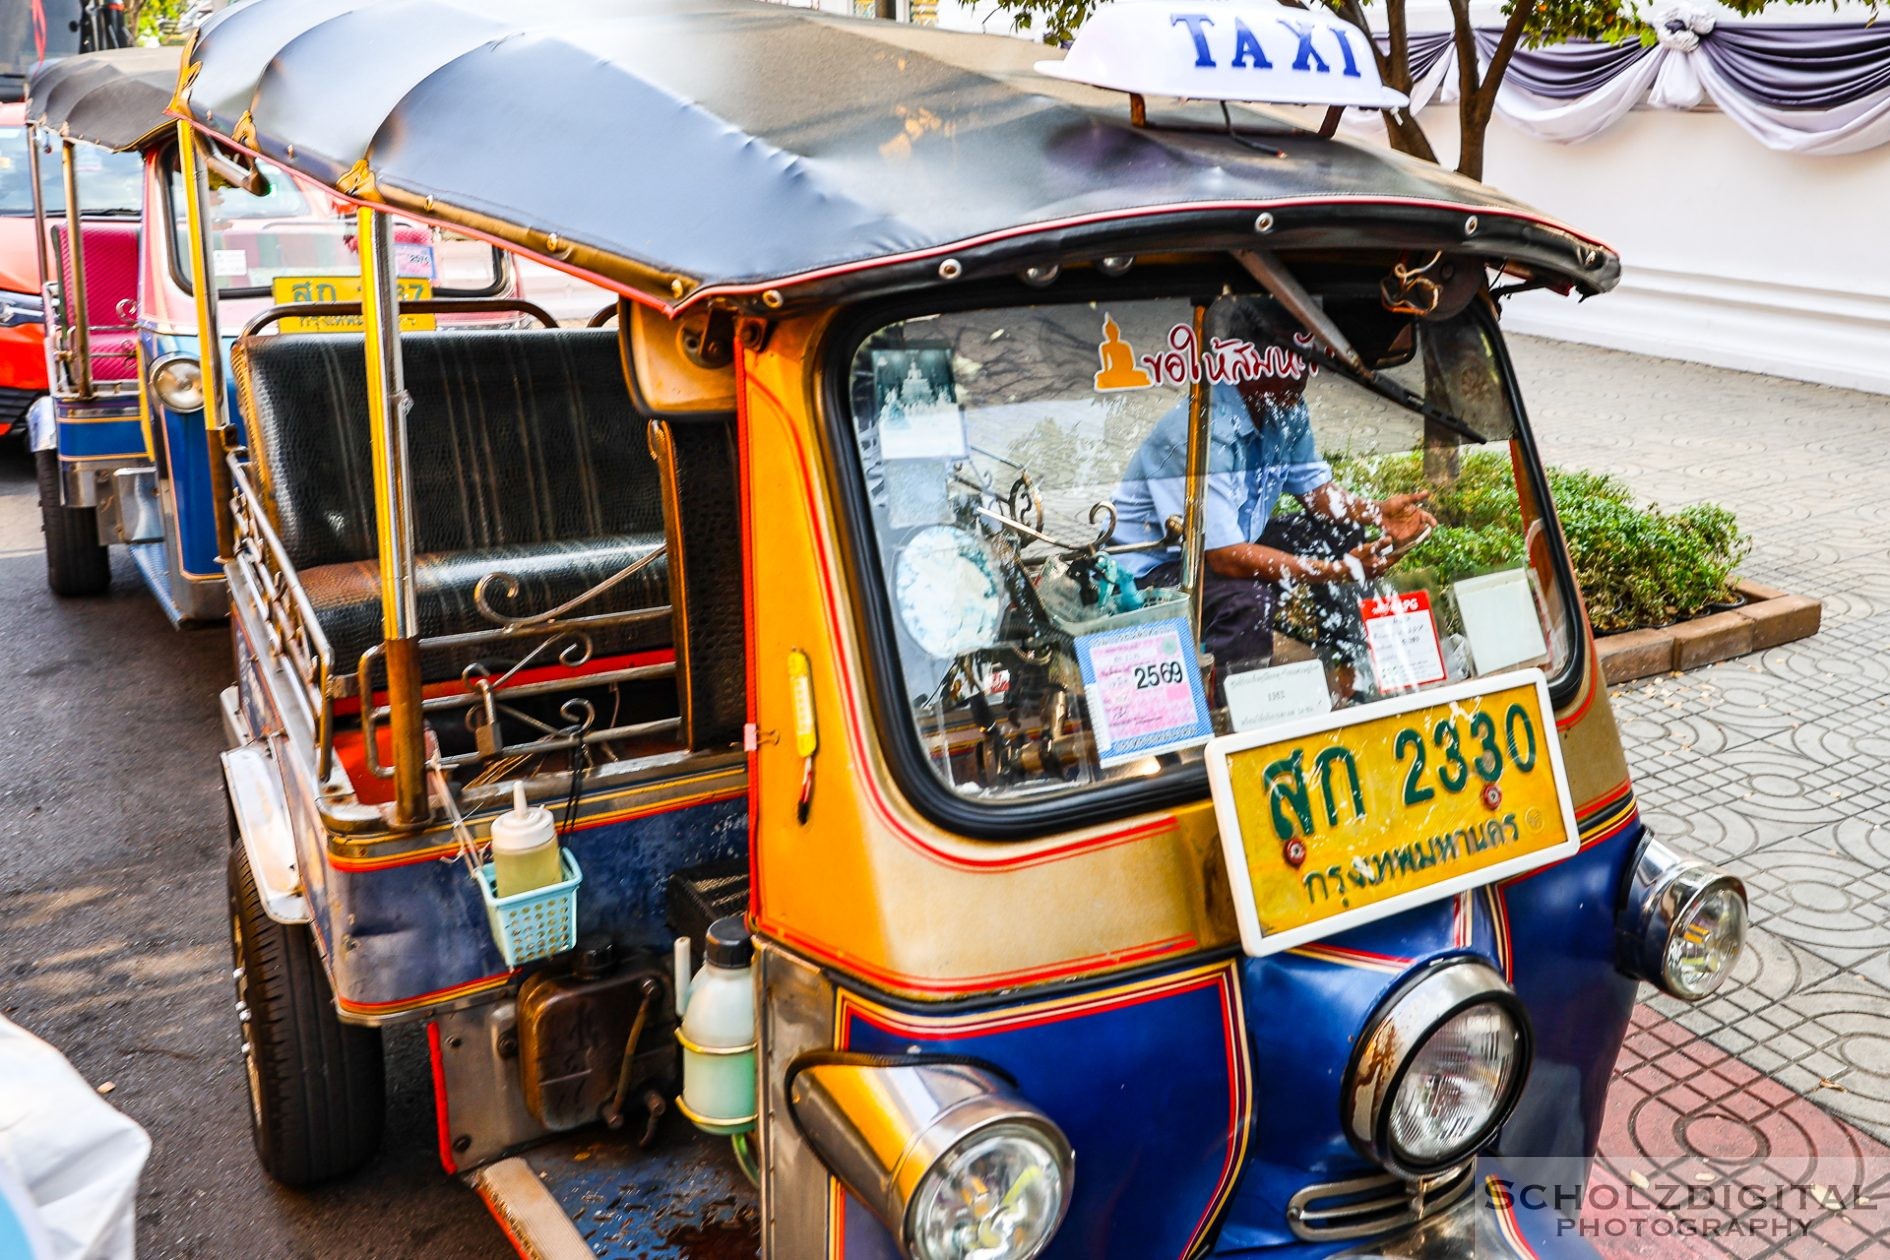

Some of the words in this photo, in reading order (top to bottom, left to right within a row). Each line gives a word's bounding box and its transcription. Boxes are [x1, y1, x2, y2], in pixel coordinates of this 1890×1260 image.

[1170, 13, 1362, 77] TAXI
[1134, 661, 1183, 690] 2569
[1262, 747, 1366, 841] สก
[1393, 703, 1537, 807] 2330
